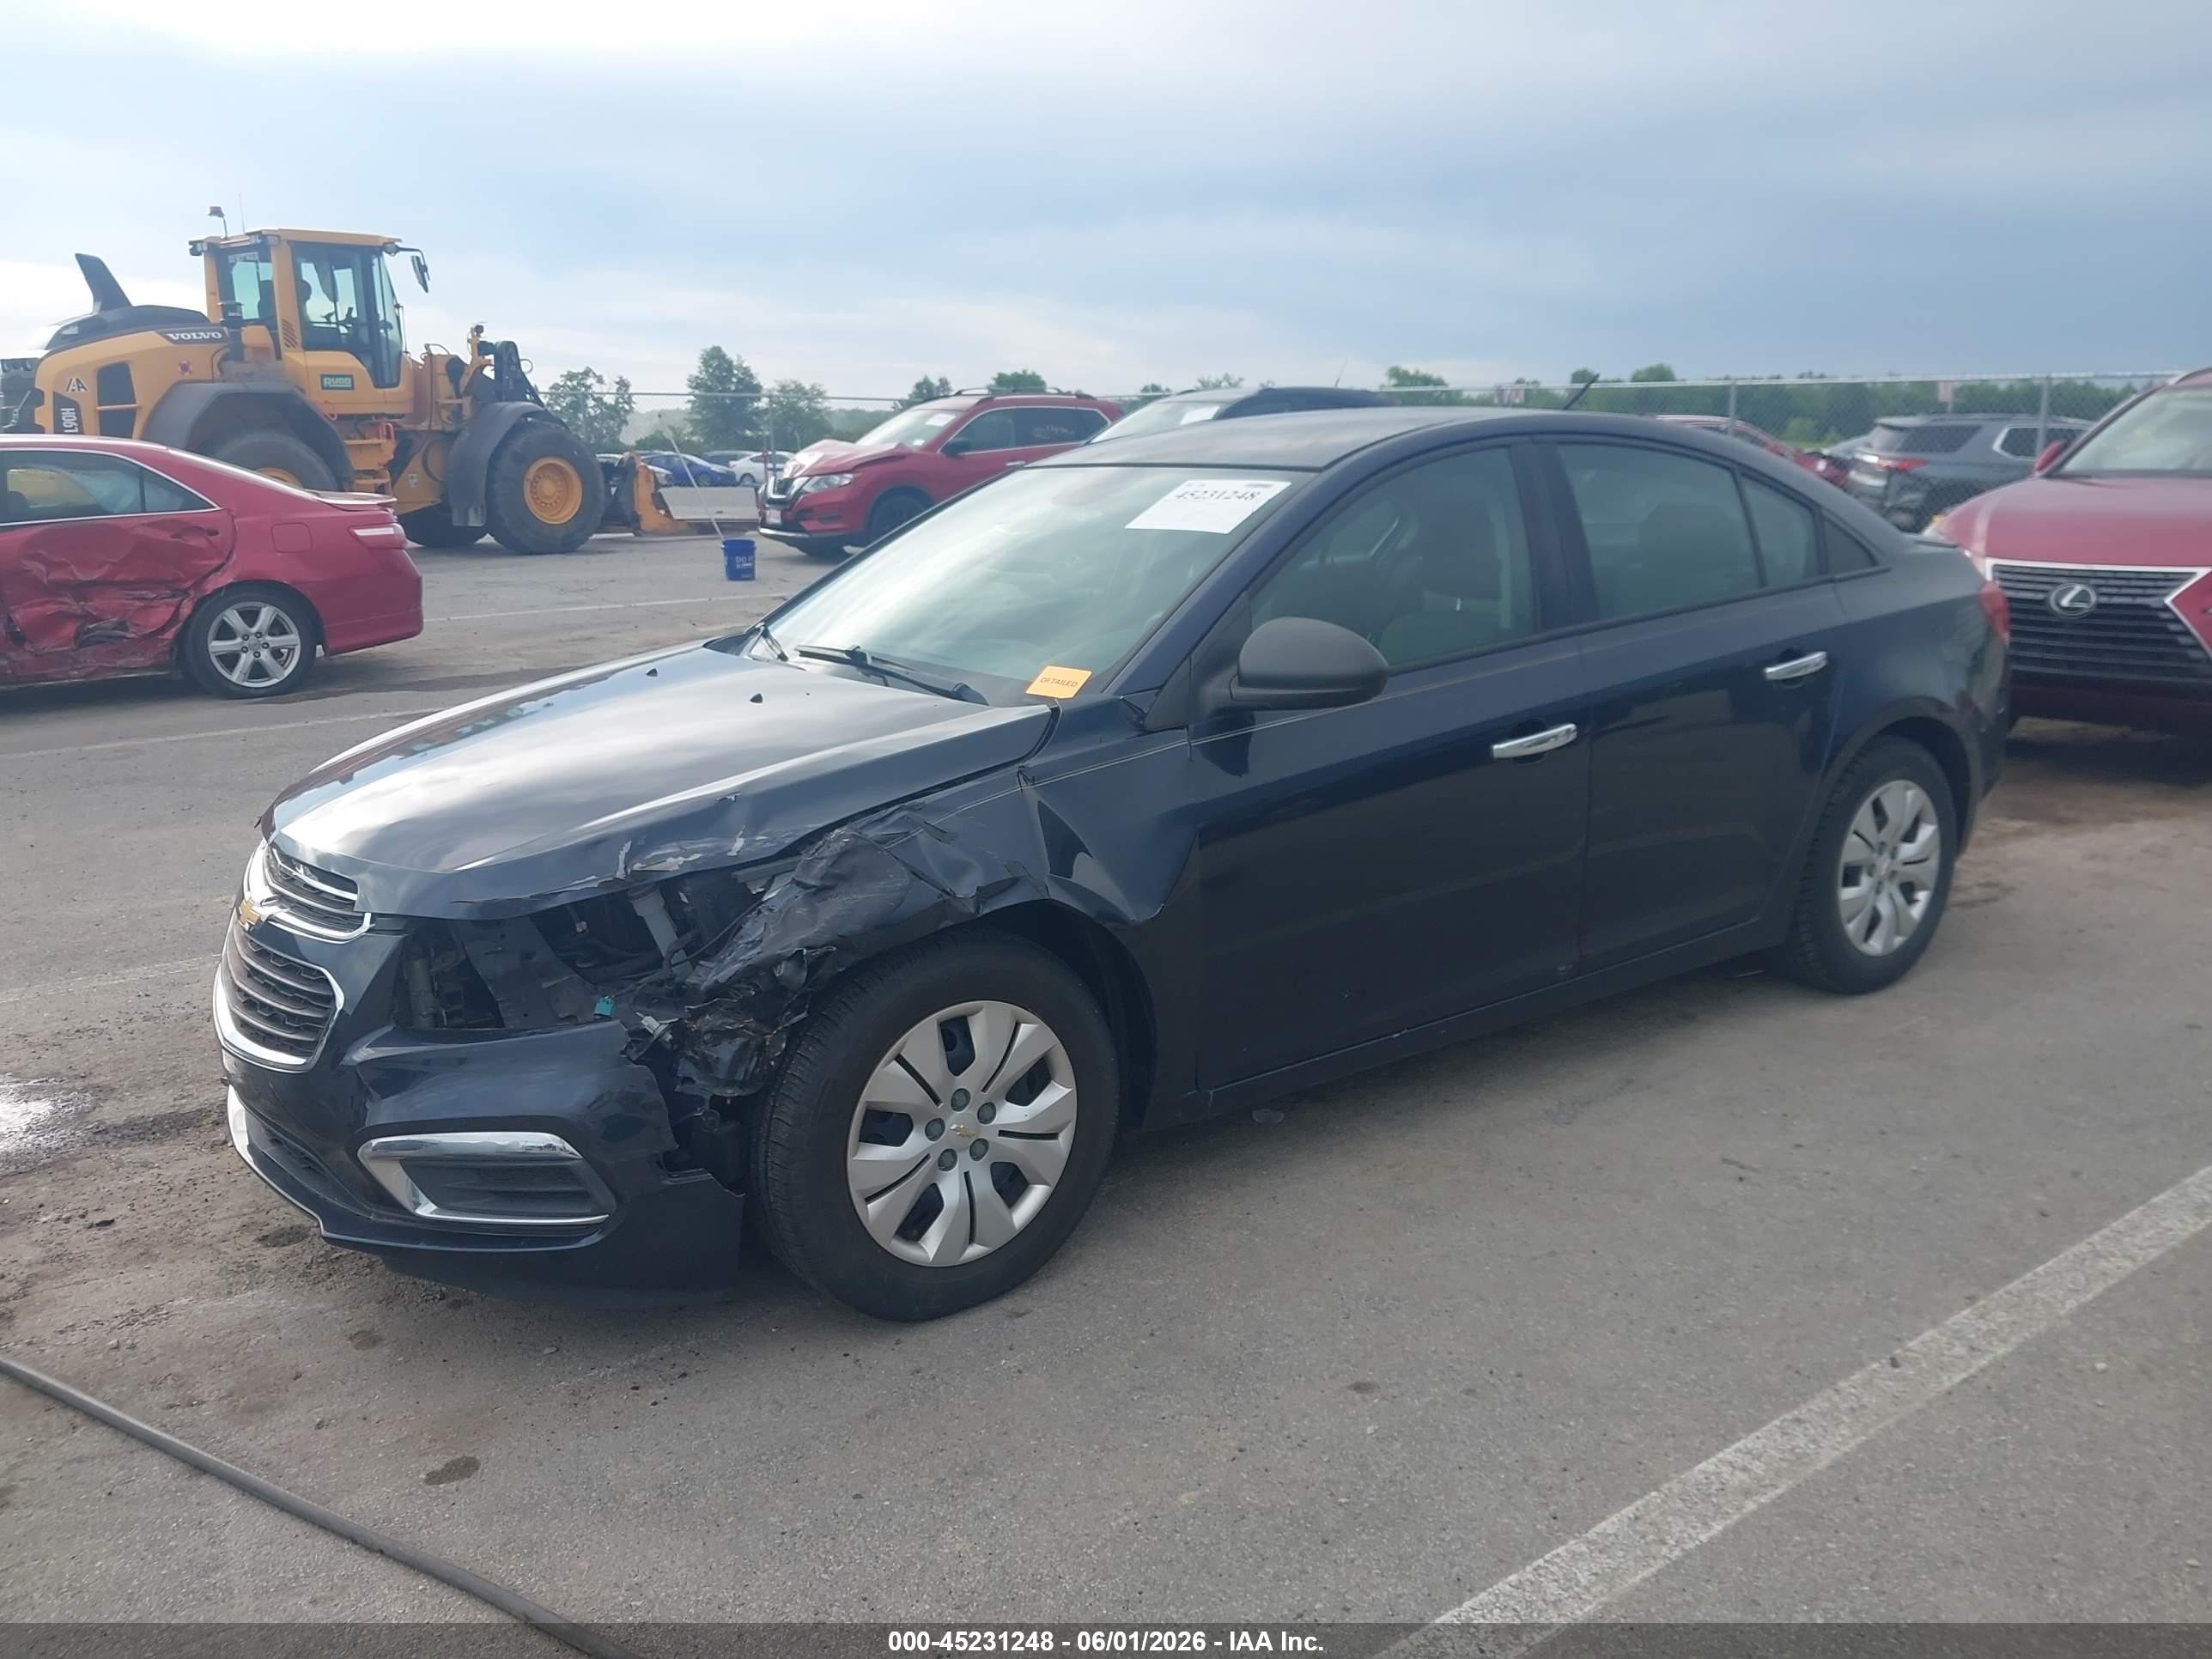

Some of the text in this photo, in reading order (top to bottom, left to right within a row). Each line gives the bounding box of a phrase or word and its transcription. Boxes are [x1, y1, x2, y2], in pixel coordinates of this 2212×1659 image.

[166, 331, 222, 340] VOLVO
[60, 407, 79, 433] L90H
[1040, 677, 1078, 688] DETAILED
